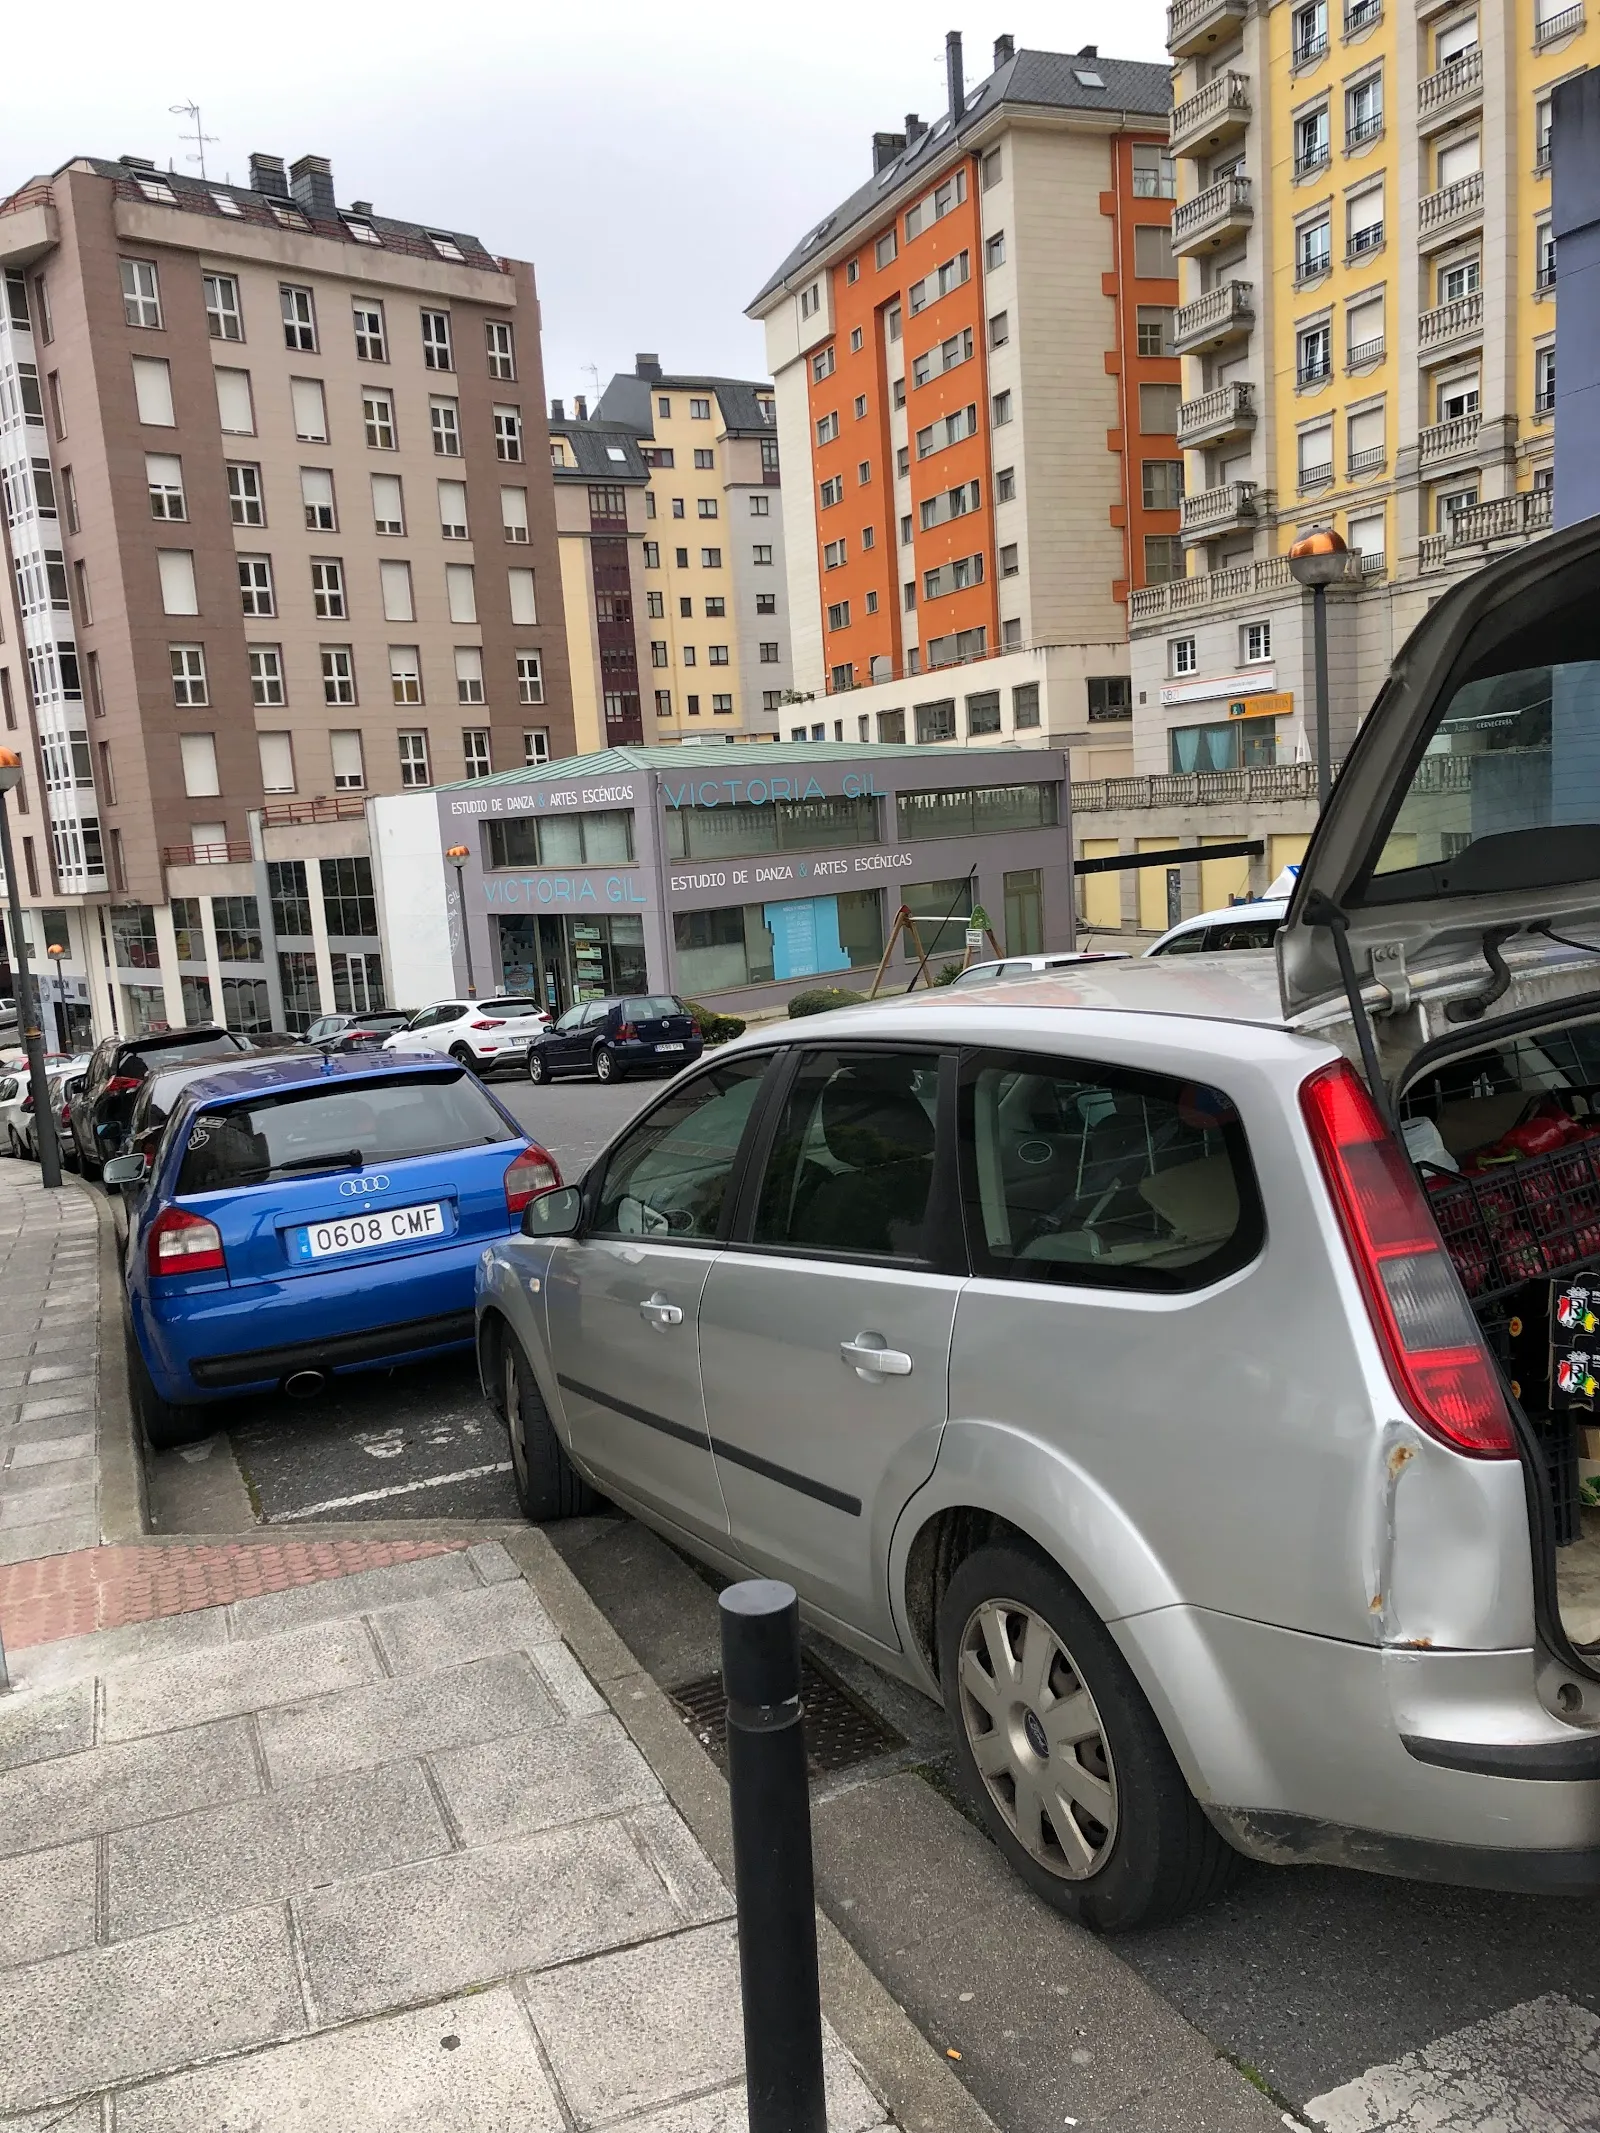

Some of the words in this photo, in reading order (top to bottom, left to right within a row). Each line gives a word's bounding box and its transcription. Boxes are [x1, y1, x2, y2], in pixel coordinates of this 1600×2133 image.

[452, 800, 488, 815] ESTUDIO
[492, 798, 503, 811] DE
[507, 796, 535, 810] DANZA
[538, 793, 545, 808] &
[550, 791, 578, 806] ARTES
[583, 786, 634, 804] ESCÉNICAS
[664, 776, 826, 810] VICTORIA
[842, 773, 889, 799] GIL
[483, 877, 598, 903] VICTORIA
[606, 876, 647, 903] GIL
[671, 873, 726, 891] ESTUDIO
[733, 870, 749, 885] DE
[756, 866, 793, 883] DANZA
[799, 863, 808, 878] &
[813, 860, 848, 876] ARTES
[855, 853, 913, 872] ESCÉNICAS
[317, 1219, 382, 1251] 0608
[391, 1208, 437, 1236] CMF
